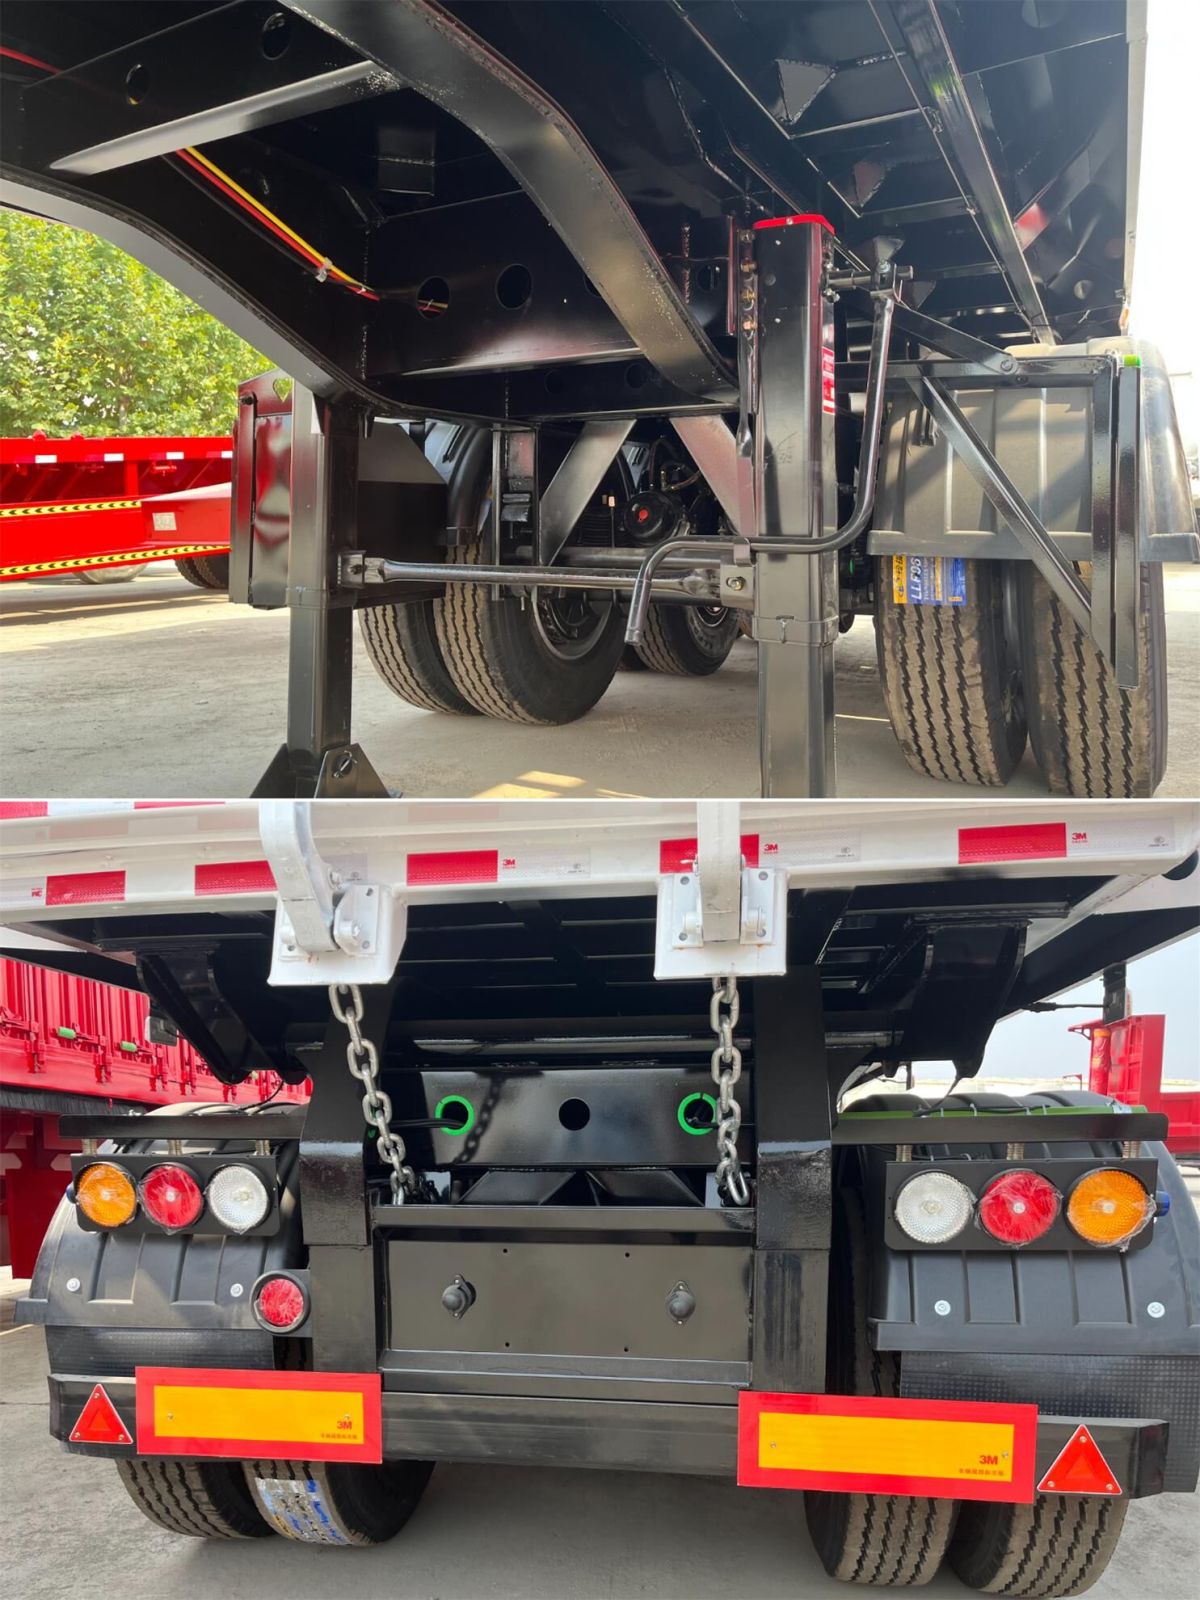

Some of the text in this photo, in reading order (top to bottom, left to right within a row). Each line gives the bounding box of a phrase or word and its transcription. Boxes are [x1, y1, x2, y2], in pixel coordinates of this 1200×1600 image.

[764, 843, 778, 851] 3M
[336, 1420, 352, 1430] 3M
[979, 1455, 998, 1465] 3M
